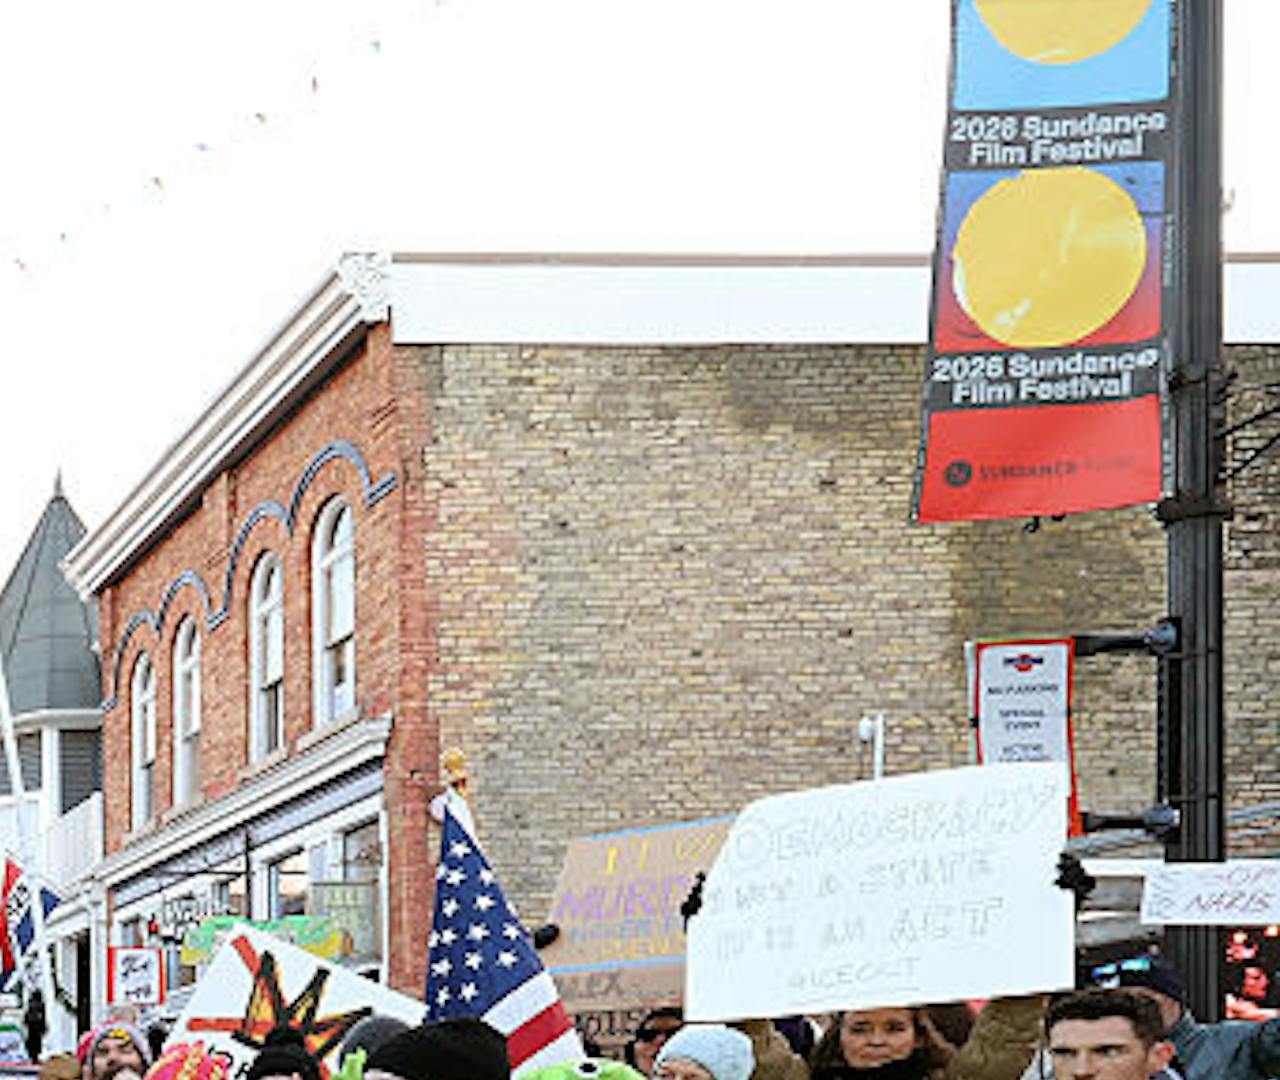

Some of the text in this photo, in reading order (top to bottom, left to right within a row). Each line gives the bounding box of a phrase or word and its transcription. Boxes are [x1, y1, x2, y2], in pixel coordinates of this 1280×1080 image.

[951, 112, 1167, 141] 2026 Sundance
[970, 136, 1142, 165] Film Festival
[932, 348, 1158, 382] 2026 Sundance
[952, 371, 1132, 405] Film Festival
